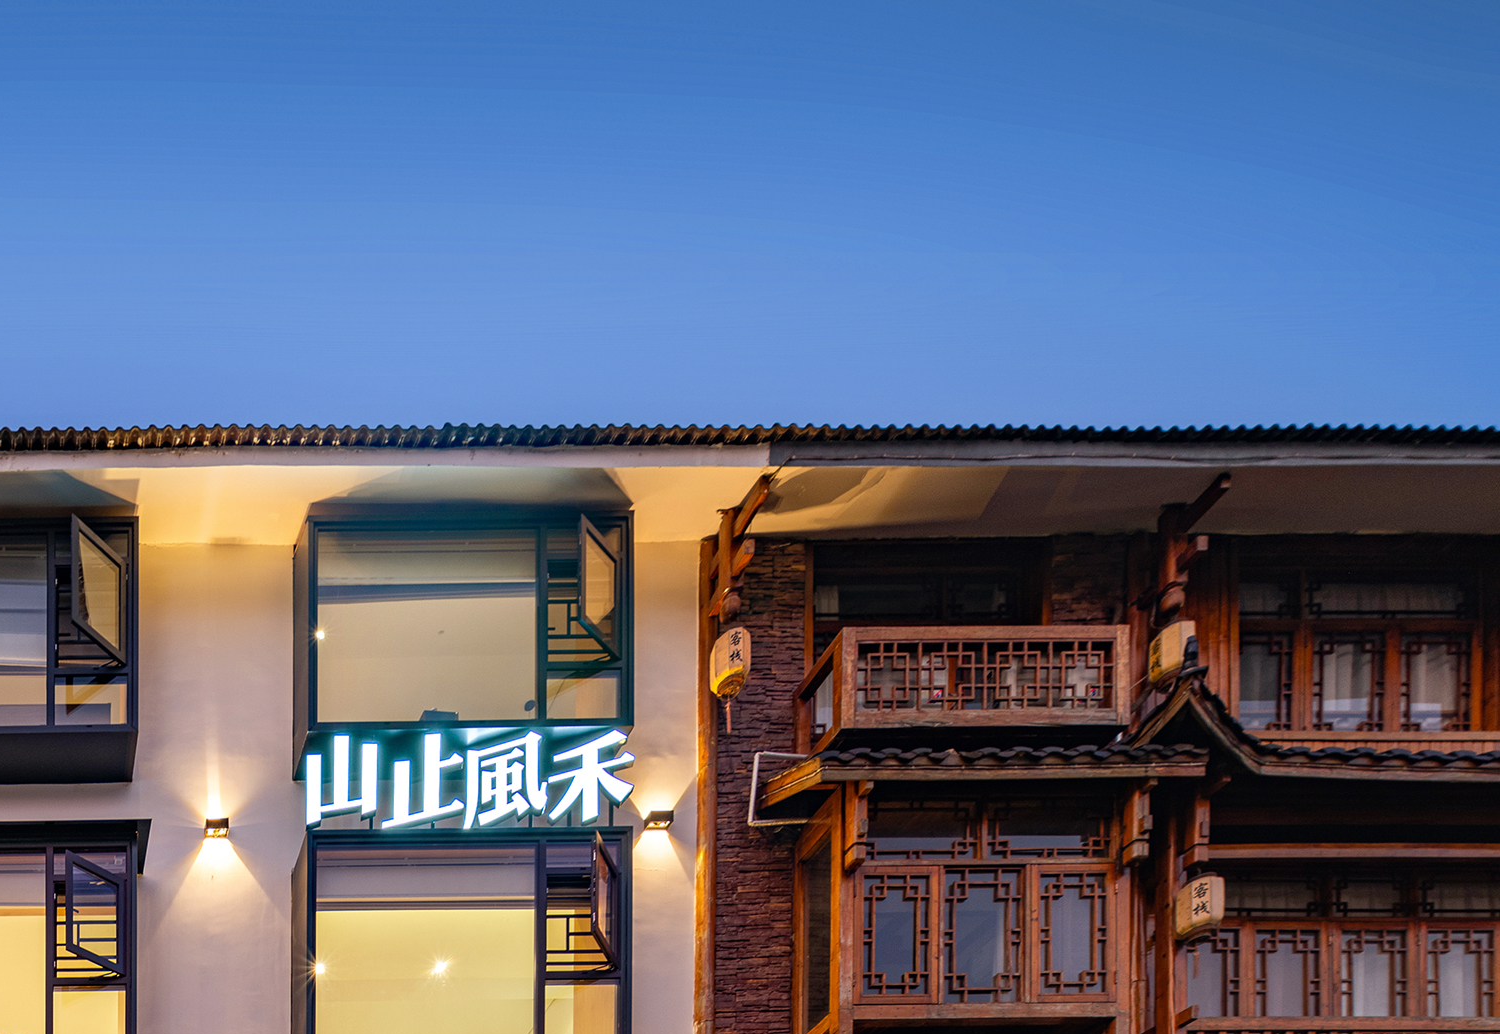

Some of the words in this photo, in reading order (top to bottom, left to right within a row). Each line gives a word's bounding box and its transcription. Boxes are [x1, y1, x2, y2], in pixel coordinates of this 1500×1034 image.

[729, 630, 743, 663] 客栈
[305, 728, 636, 831] 山止風禾
[1192, 882, 1210, 916] 客栈
